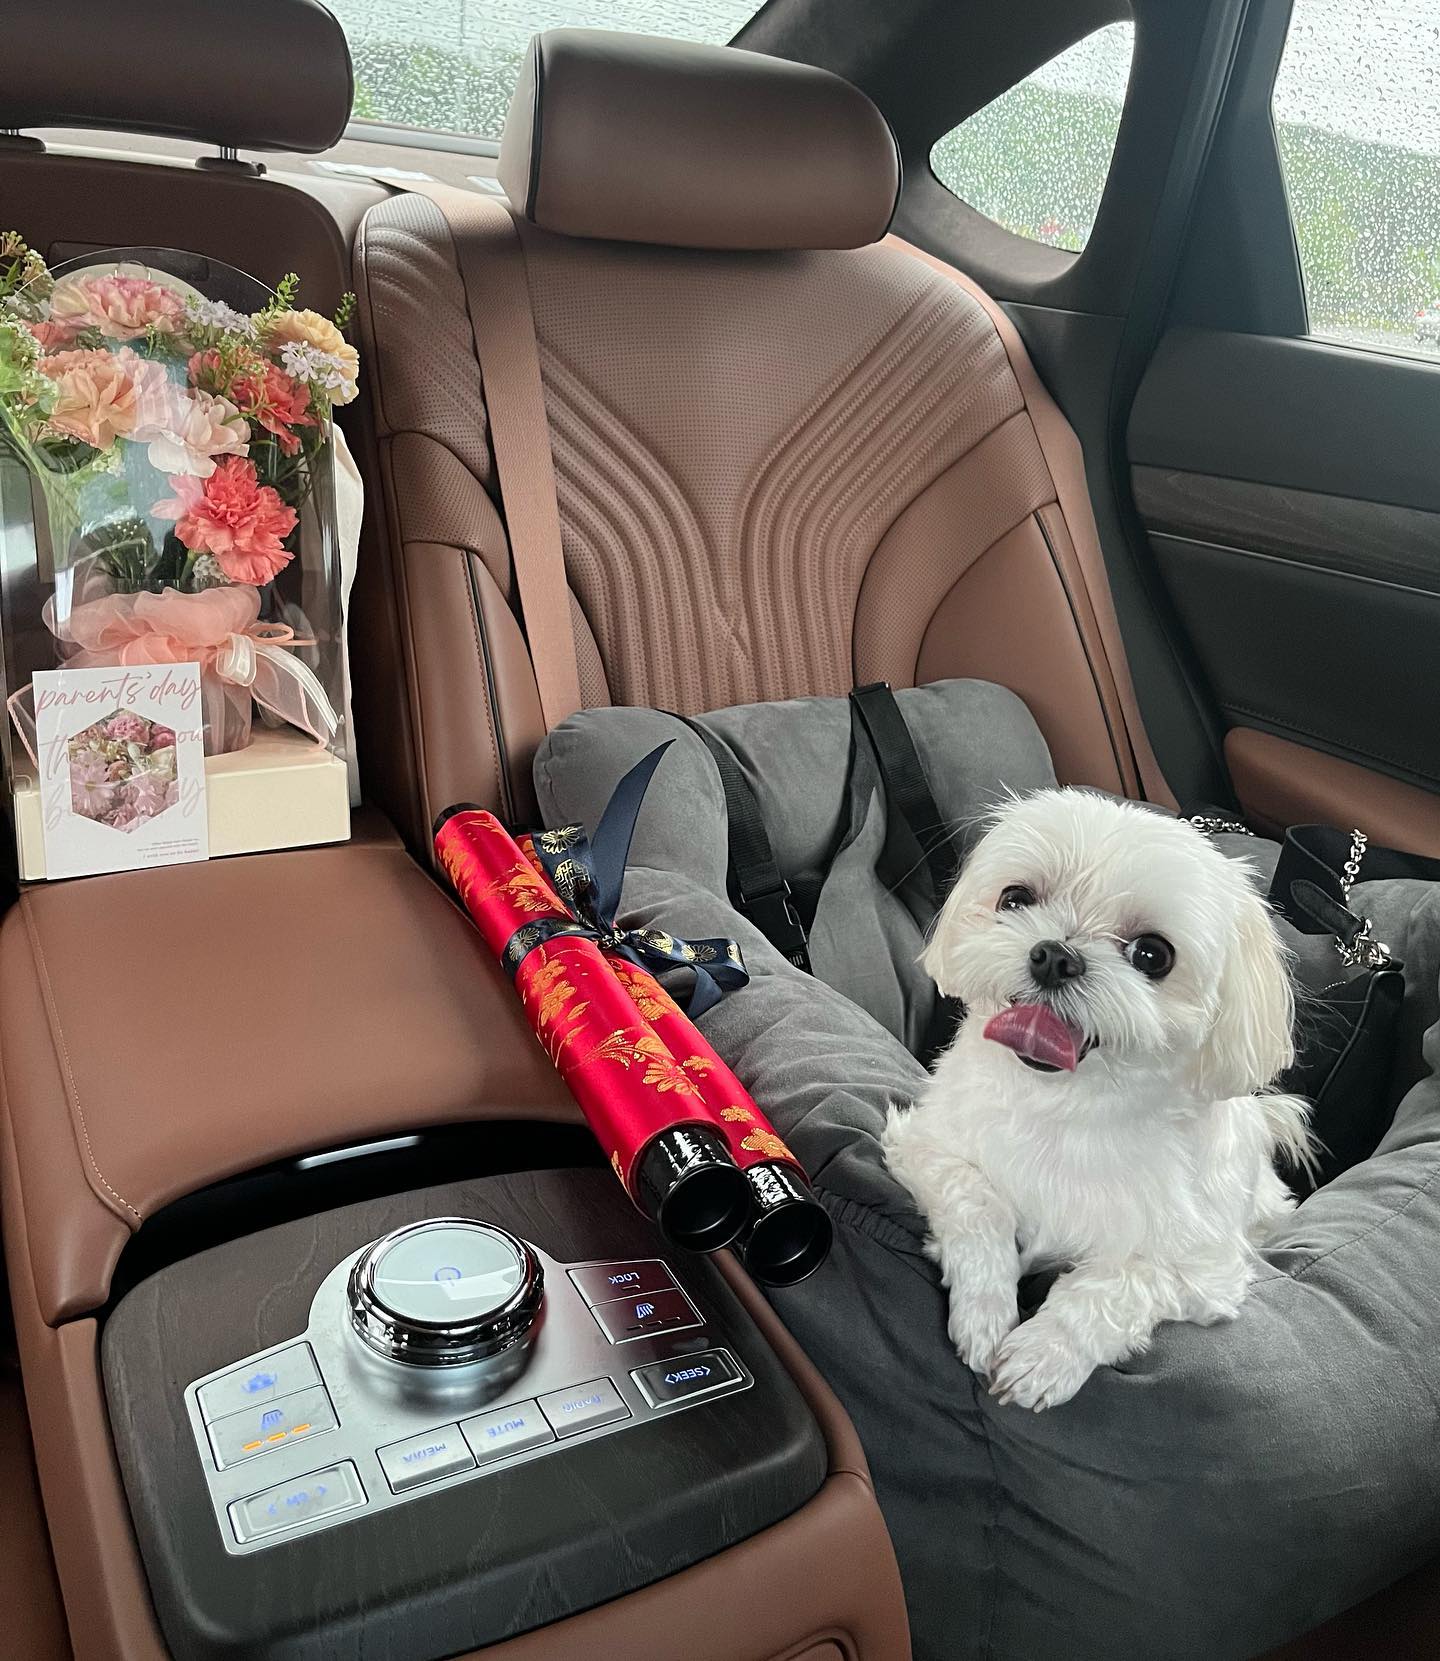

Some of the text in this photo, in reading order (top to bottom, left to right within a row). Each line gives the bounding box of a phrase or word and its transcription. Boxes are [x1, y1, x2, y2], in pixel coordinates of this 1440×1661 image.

[150, 669, 201, 710] day
[177, 729, 203, 744] ou
[608, 1272, 640, 1285] LOCK
[486, 1418, 525, 1438] MUTE
[403, 1443, 446, 1464] MEDIA
